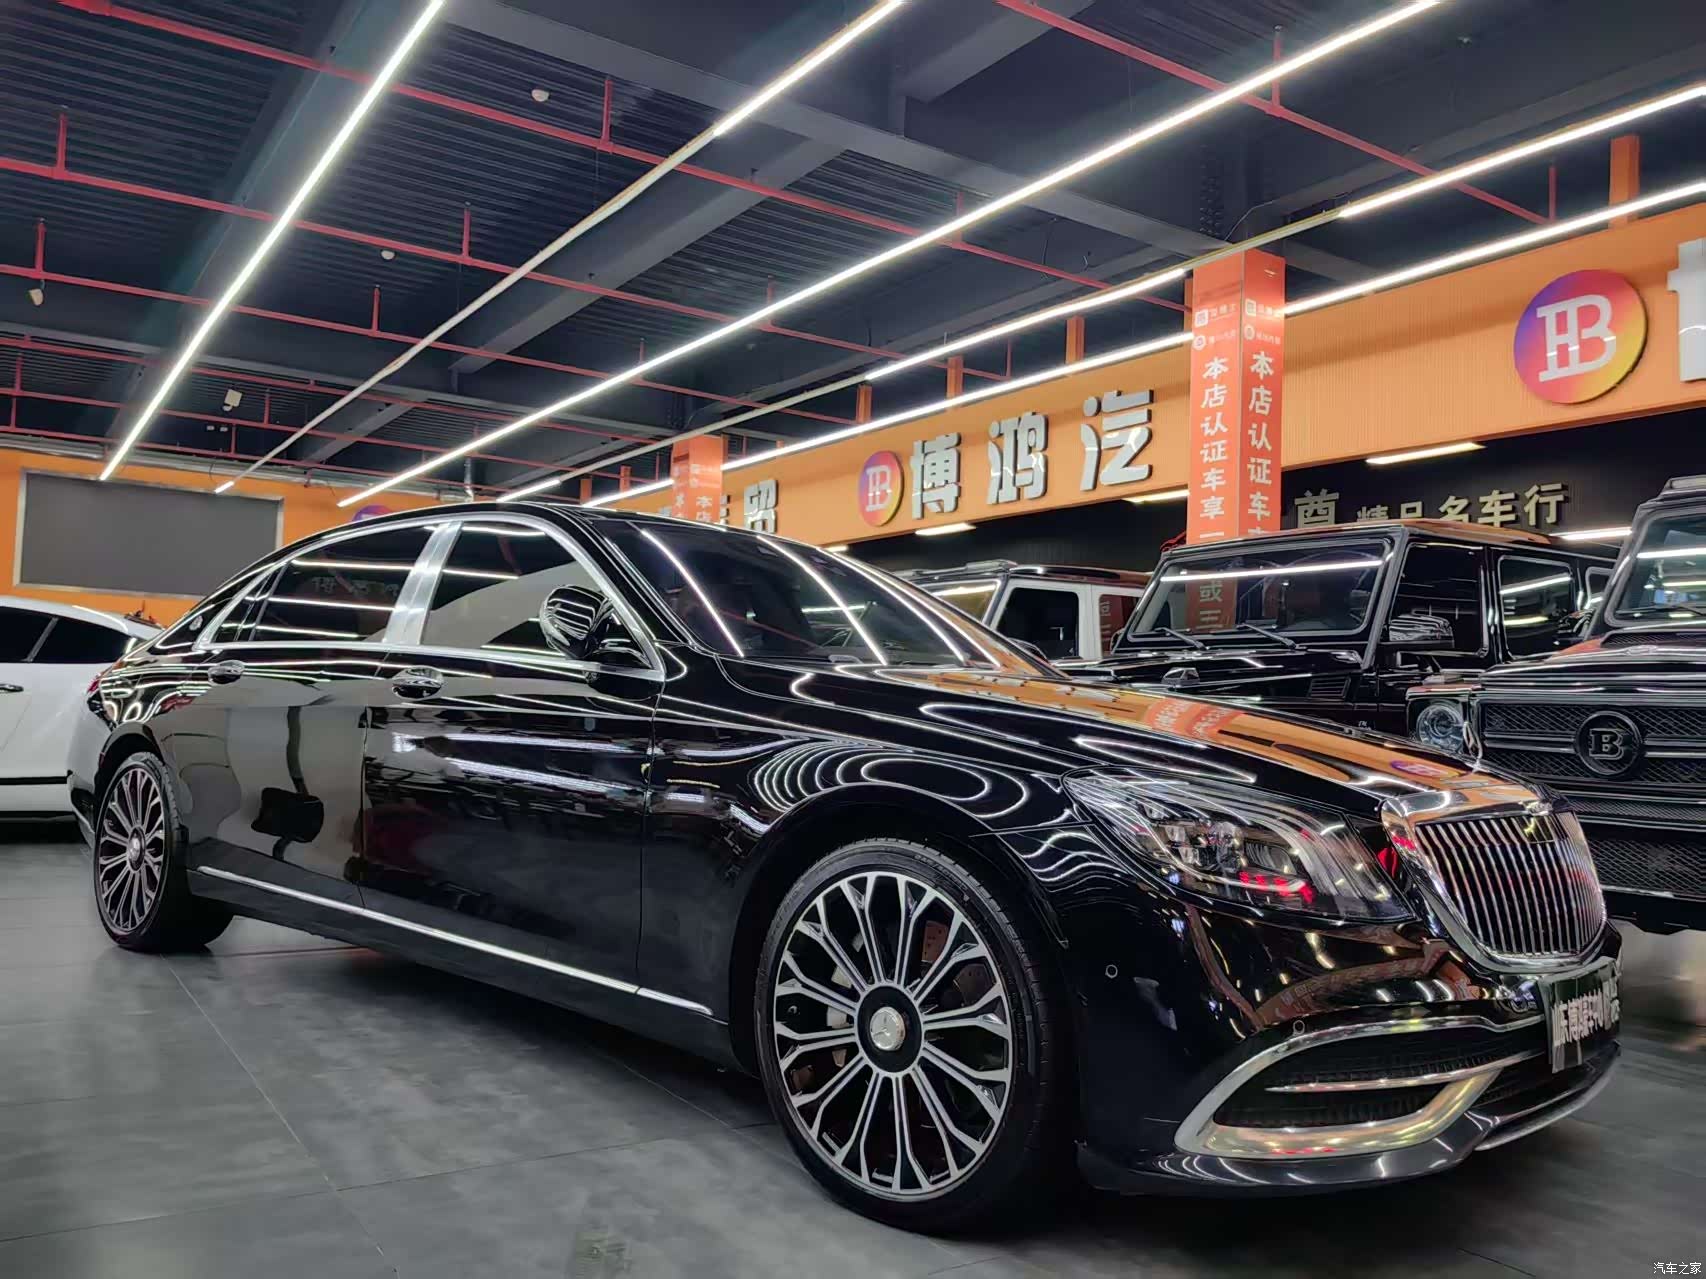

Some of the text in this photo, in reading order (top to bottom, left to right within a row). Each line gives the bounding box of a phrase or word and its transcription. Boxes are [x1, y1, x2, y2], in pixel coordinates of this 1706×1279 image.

[909, 390, 1153, 520] 博鸿汽
[1200, 356, 1229, 539] 本店认证车享一
[1589, 727, 1625, 760] B
